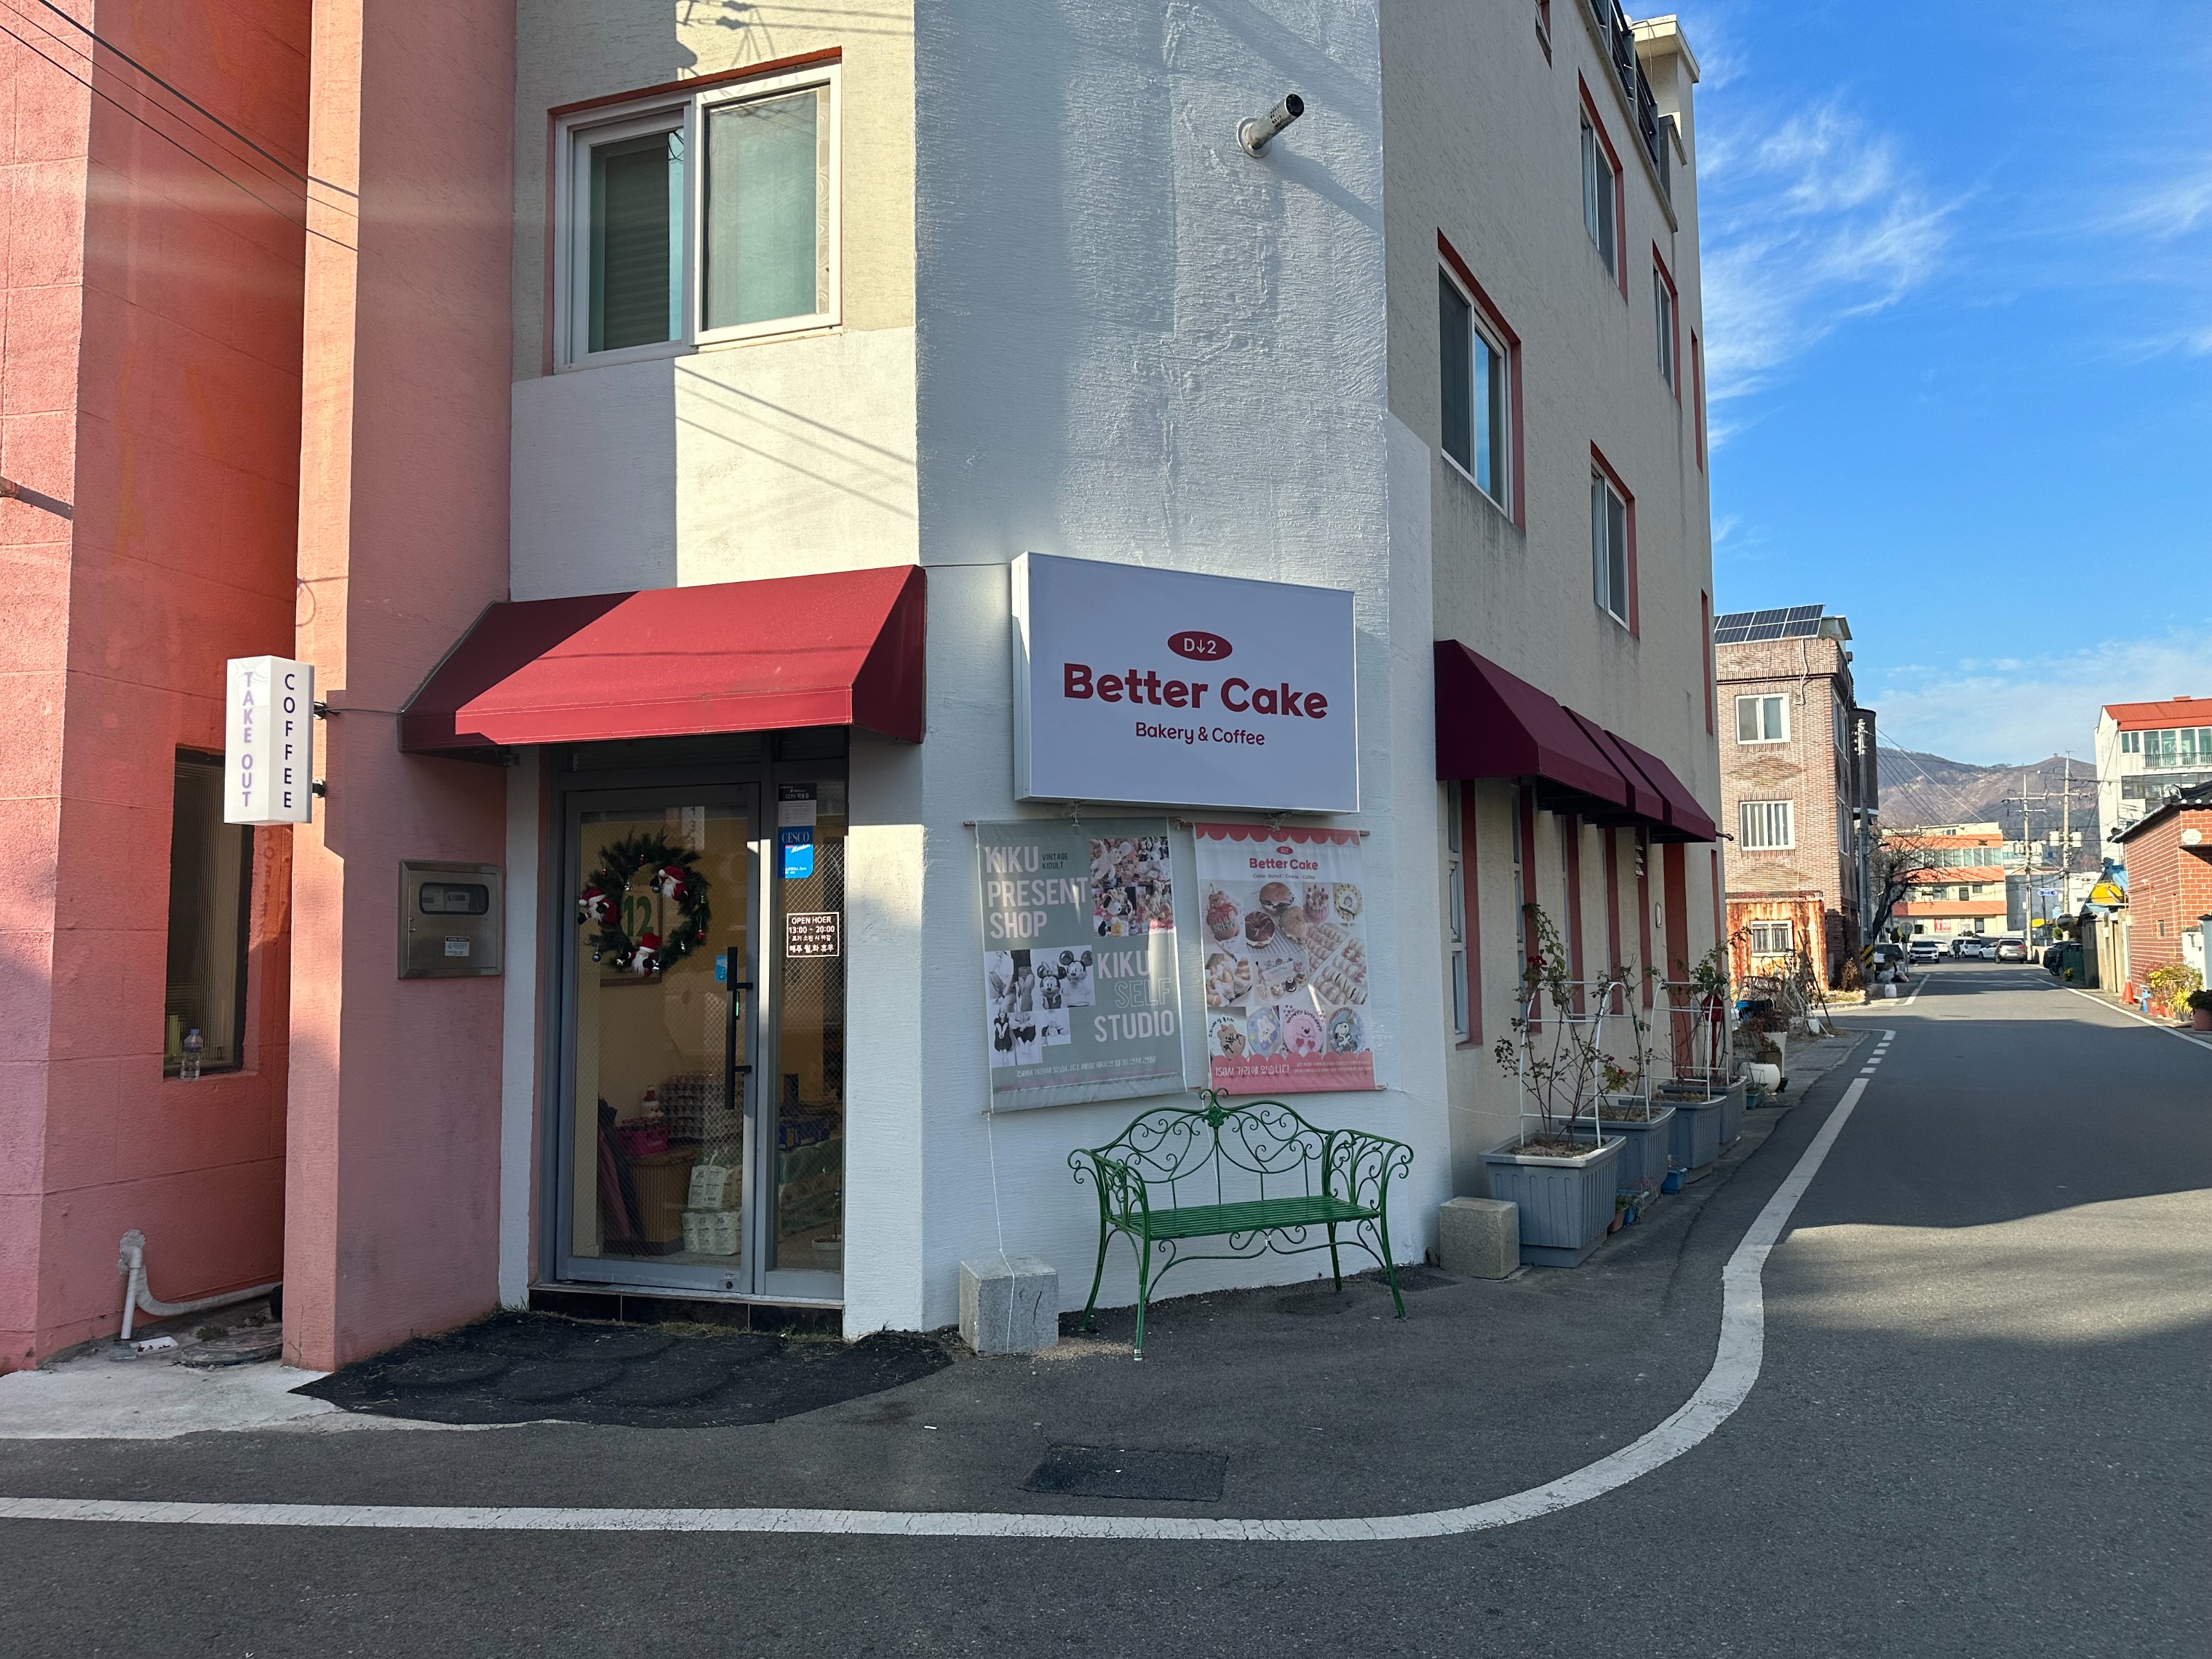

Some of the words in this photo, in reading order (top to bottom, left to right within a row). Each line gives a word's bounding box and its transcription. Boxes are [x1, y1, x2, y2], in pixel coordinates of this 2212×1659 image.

[1064, 663, 1208, 709] Better
[1220, 677, 1328, 719] Cake
[242, 672, 254, 743] TAKE
[283, 673, 295, 808] COFFEE
[1136, 722, 1194, 744] Bakery
[1198, 727, 1209, 742] &
[1212, 728, 1265, 746] Coffee
[242, 754, 253, 807] OUT
[781, 832, 810, 843] CESCO
[985, 846, 1039, 873] KIKU
[1042, 853, 1069, 861] VINTAGE
[1042, 862, 1064, 870] KIDULT
[1249, 858, 1288, 869] Better
[1289, 859, 1318, 870] Cake
[987, 877, 1088, 907] PRESENT
[816, 926, 835, 934] 20:00
[990, 911, 1047, 939] SHOP
[789, 944, 803, 953] 매주
[821, 944, 834, 952] 휴무
[1097, 950, 1150, 979] KIKU
[1114, 978, 1171, 1008] SELF
[1094, 1009, 1174, 1043] STUDIO
[1215, 1067, 1234, 1077] 150M
[1236, 1065, 1259, 1075] 거리에
